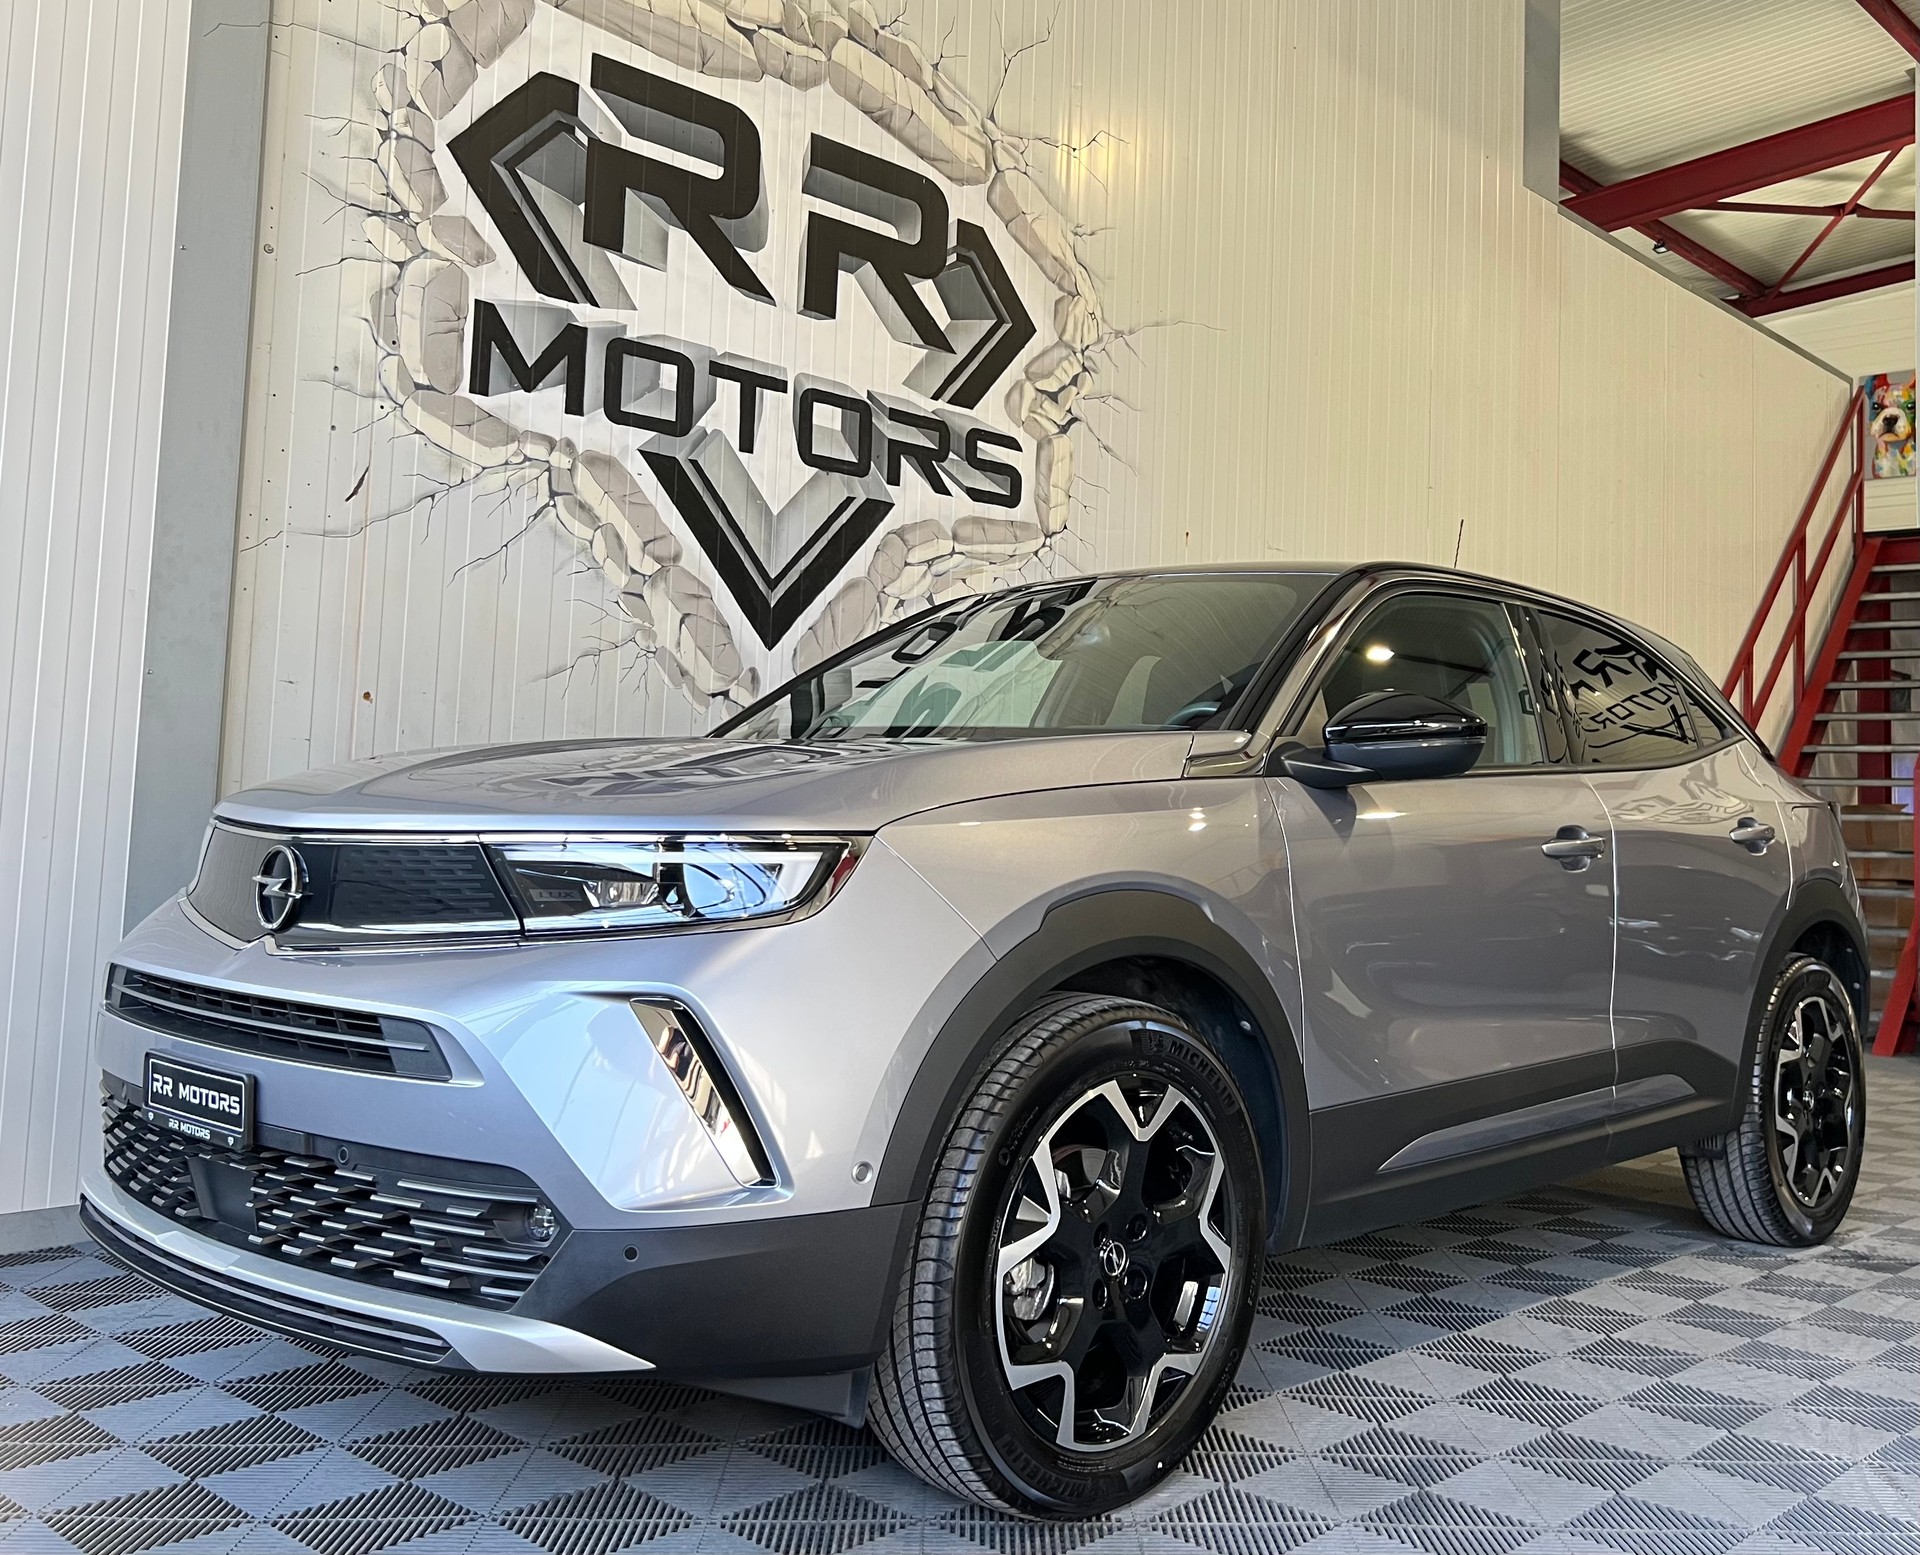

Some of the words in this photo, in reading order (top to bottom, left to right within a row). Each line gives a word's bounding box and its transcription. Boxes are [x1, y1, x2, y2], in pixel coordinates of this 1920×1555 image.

[583, 52, 956, 354] RR
[469, 298, 1022, 508] MOTORS
[152, 1073, 173, 1098] RR
[178, 1082, 240, 1115] MOTORS
[1168, 1040, 1237, 1110] MICHELIN
[168, 1118, 179, 1131] RR
[180, 1121, 211, 1140] MOTORS
